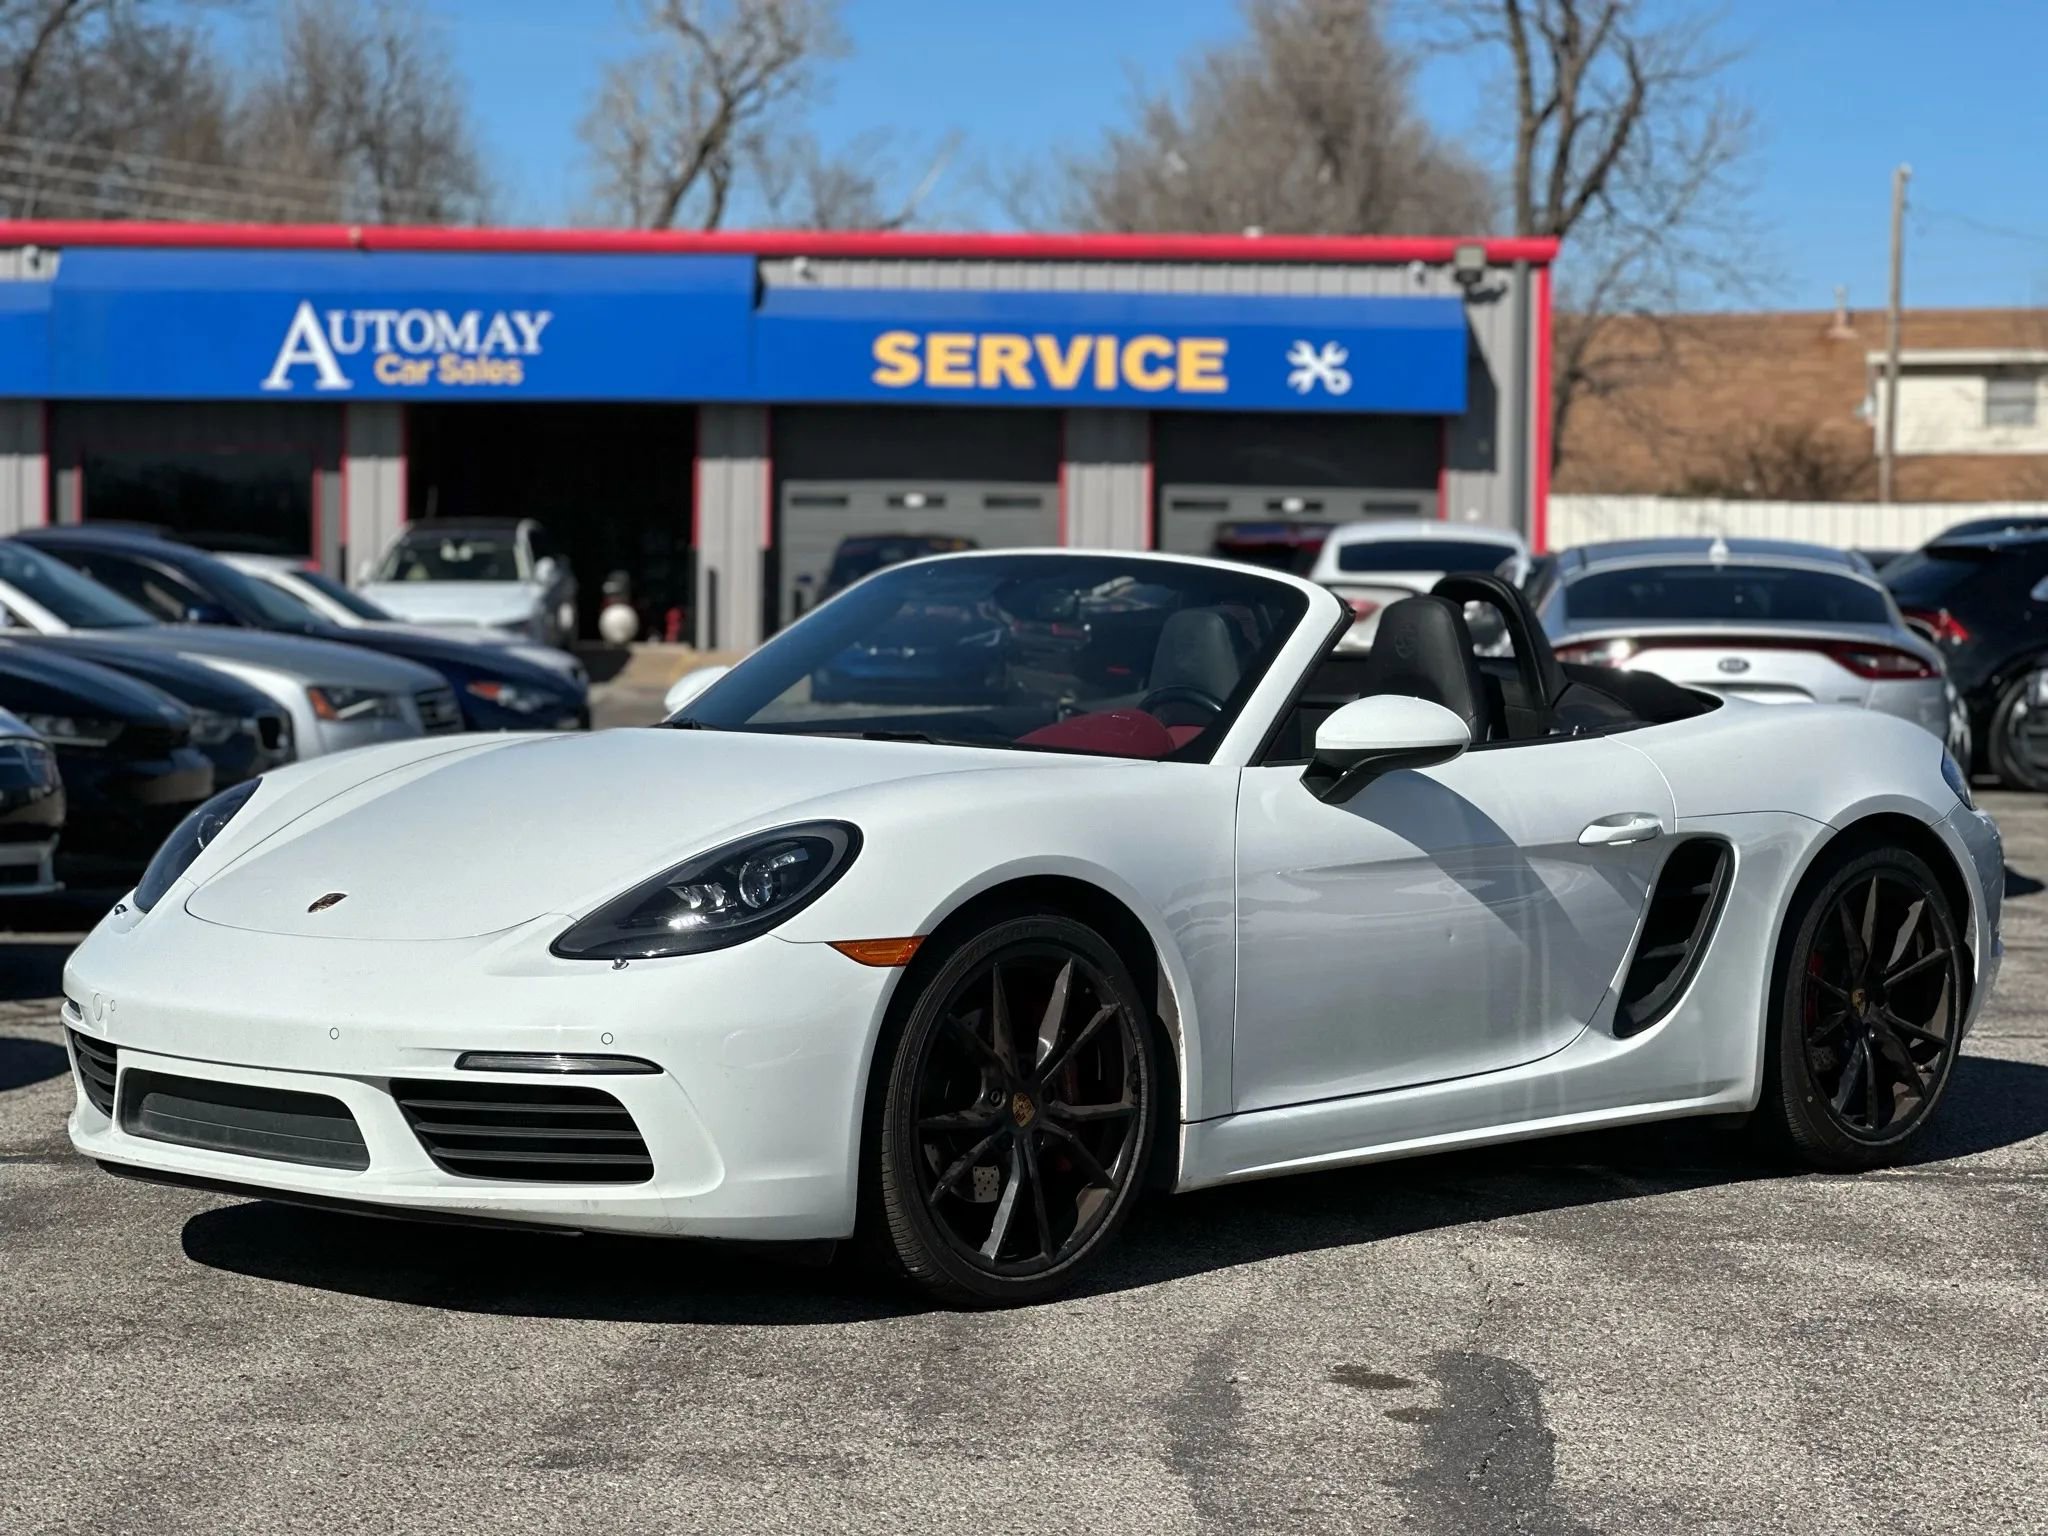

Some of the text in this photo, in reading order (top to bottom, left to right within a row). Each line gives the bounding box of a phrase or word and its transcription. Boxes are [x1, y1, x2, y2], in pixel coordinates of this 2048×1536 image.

[260, 299, 553, 391] AUTOMAY
[374, 353, 525, 386] Car Sales
[872, 330, 1229, 393] SERVICE
